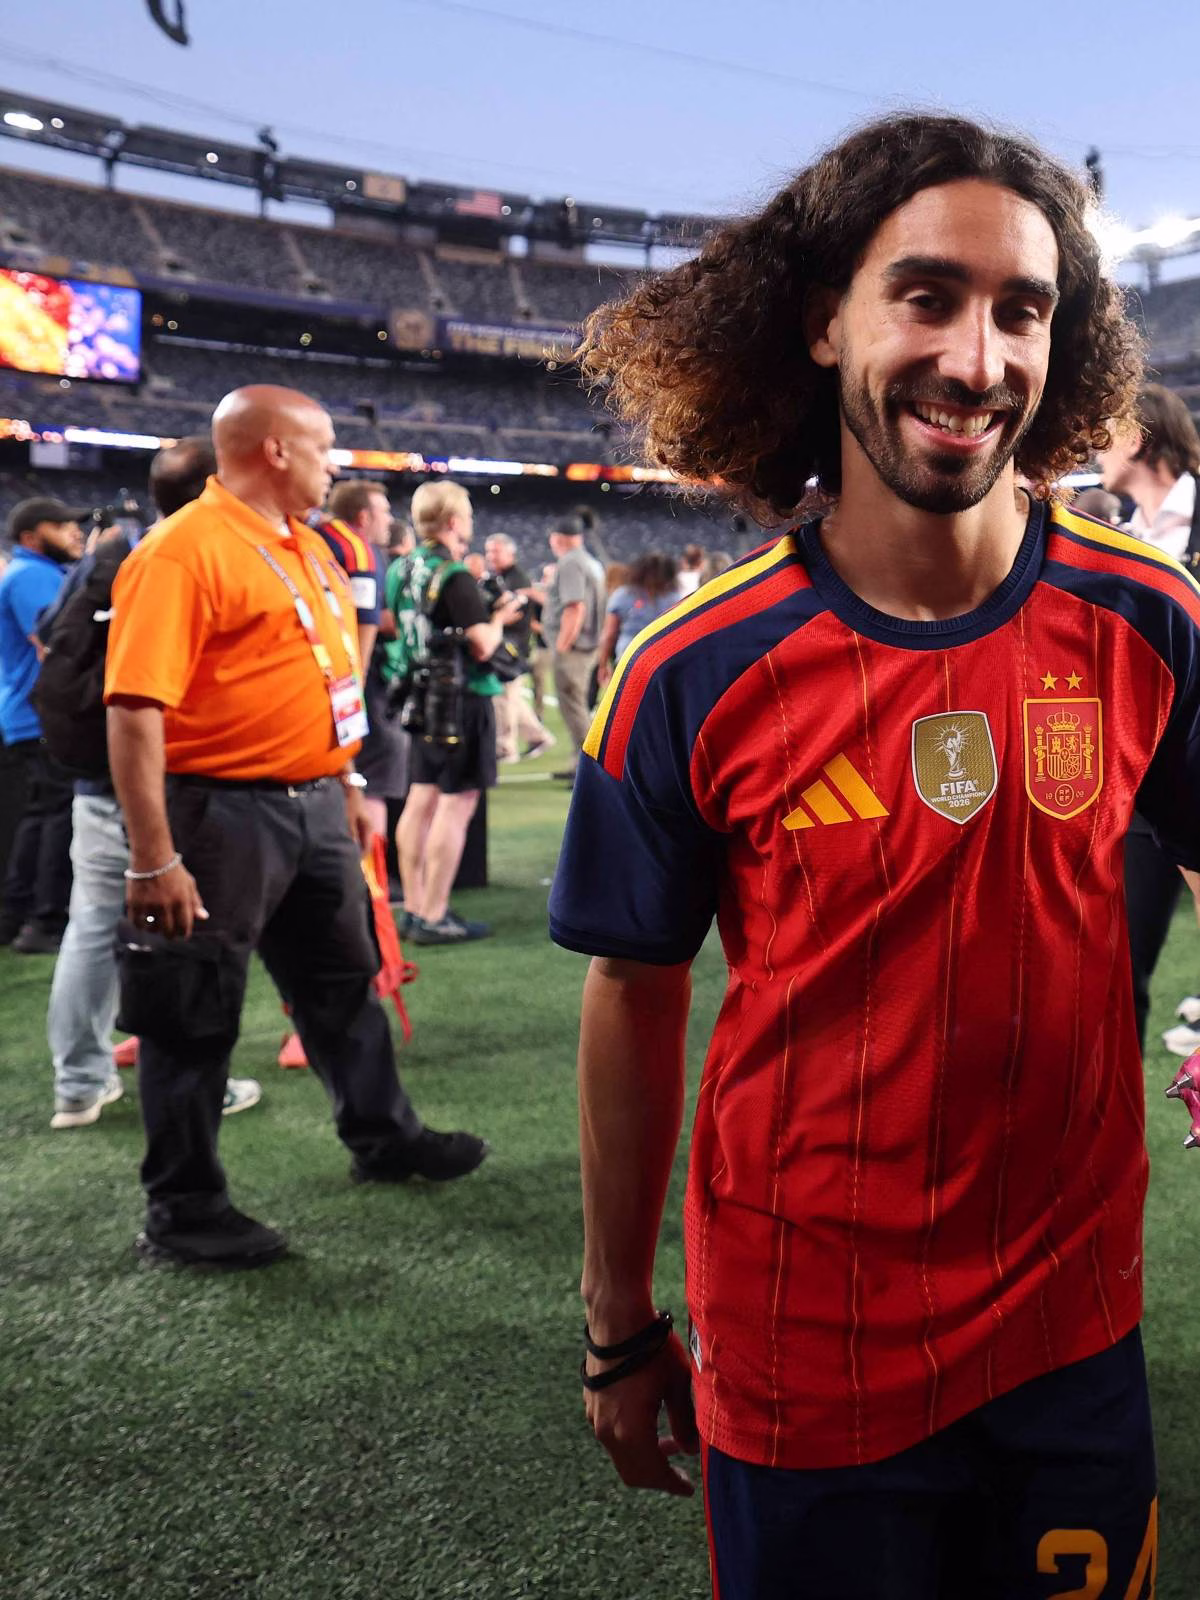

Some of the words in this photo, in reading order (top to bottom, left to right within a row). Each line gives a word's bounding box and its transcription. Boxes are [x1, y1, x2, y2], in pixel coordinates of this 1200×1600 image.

[940, 780, 977, 796] FIFA
[930, 795, 952, 803] WORLD
[952, 790, 987, 801] CHAMPIONS
[949, 799, 971, 808] 2026
